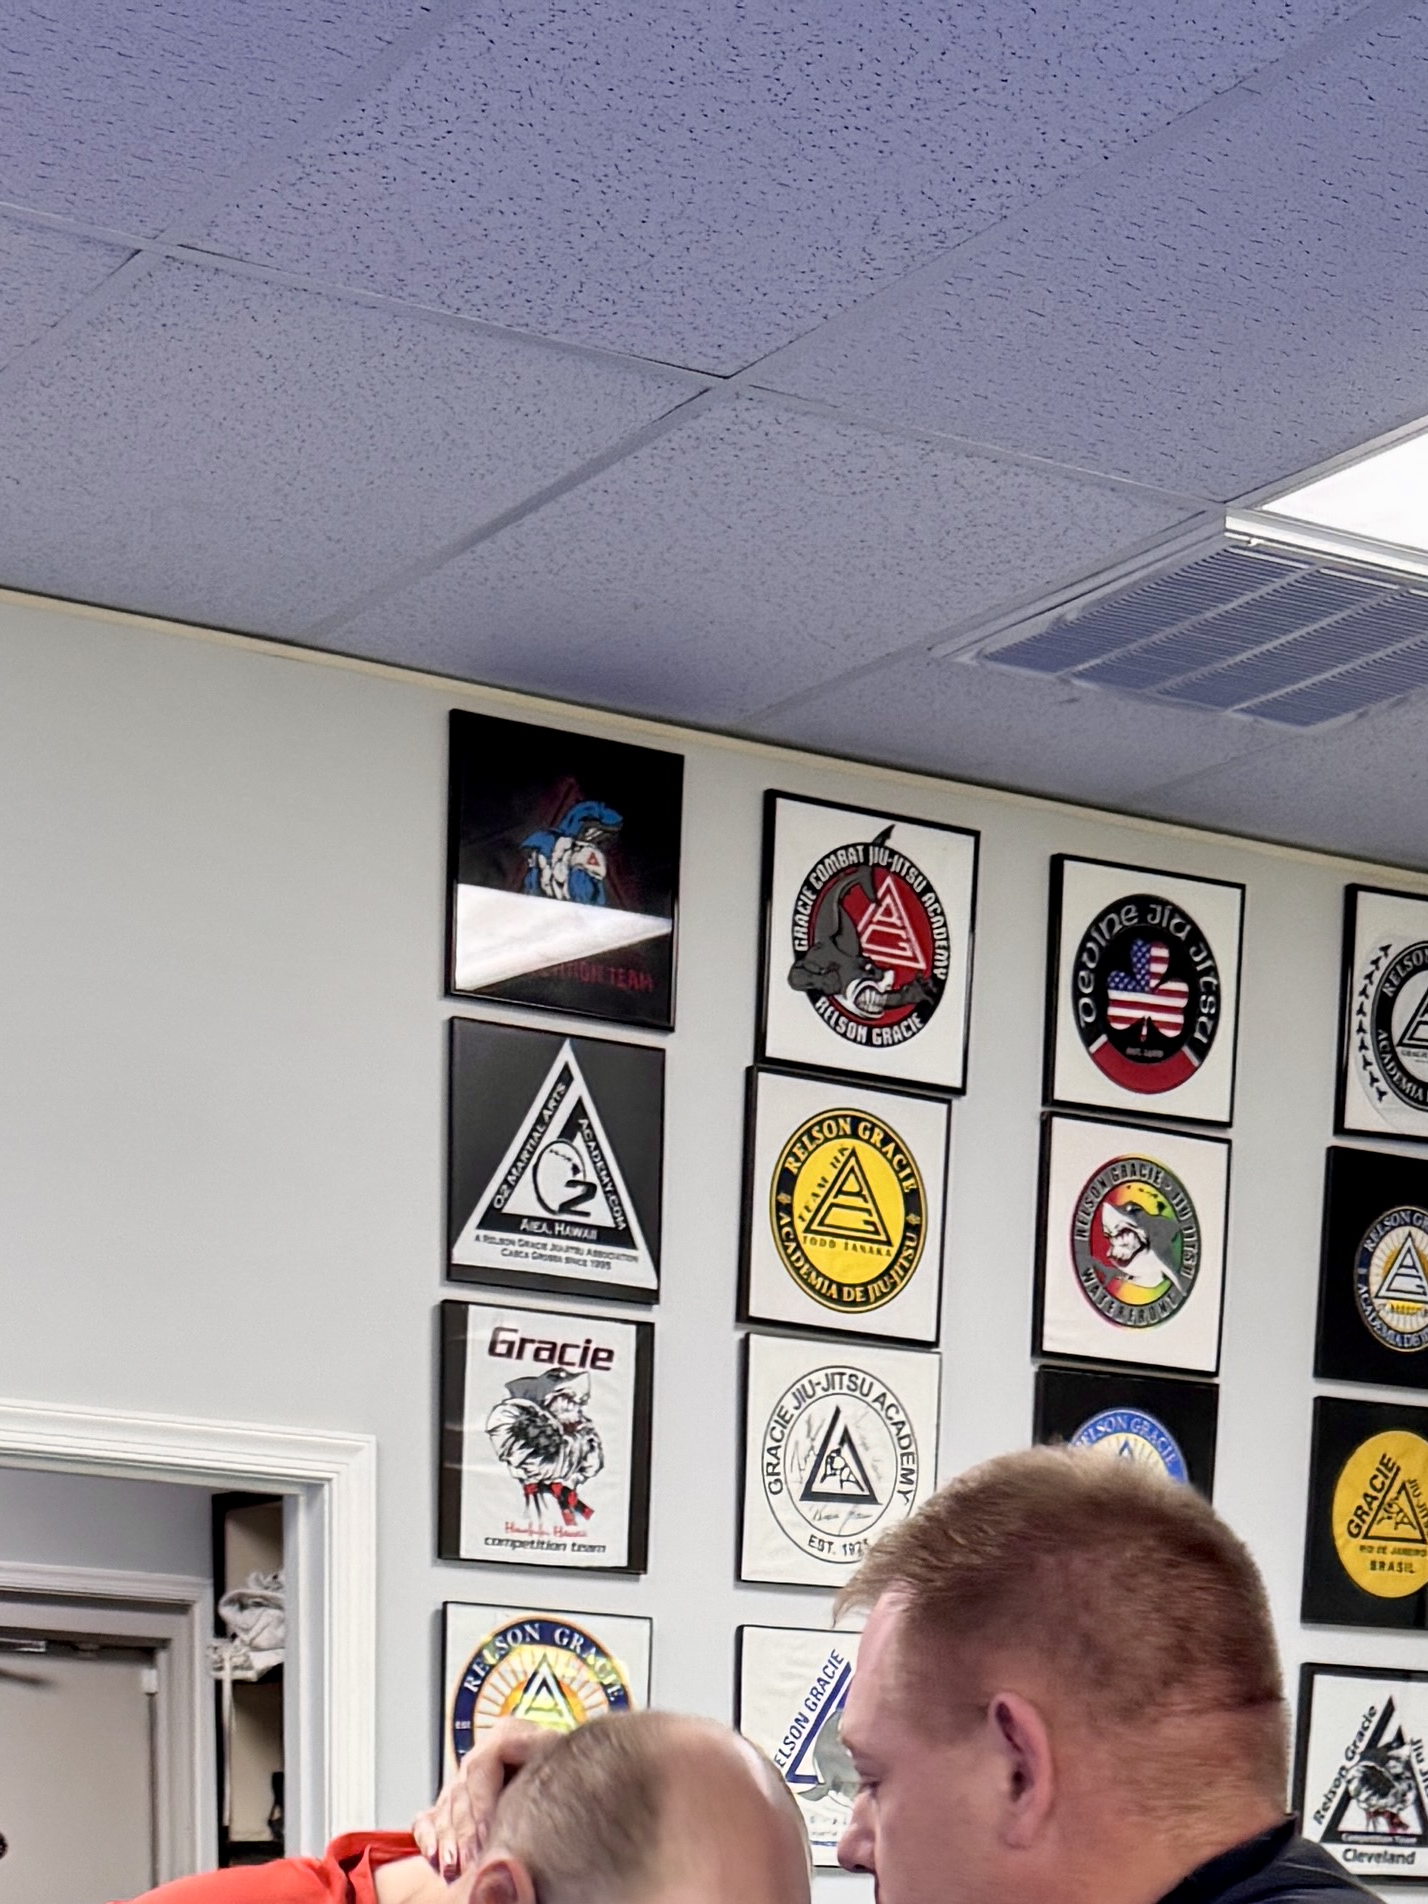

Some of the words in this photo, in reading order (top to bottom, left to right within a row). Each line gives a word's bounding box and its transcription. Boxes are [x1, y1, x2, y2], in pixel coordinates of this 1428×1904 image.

[794, 885, 816, 952] GRACIE
[809, 845, 865, 891] COMBAT
[923, 892, 950, 980] ACADEMY
[815, 996, 868, 1044] RELSON
[872, 1012, 924, 1046] GRACIE
[505, 1123, 546, 1186] MARTIAL
[542, 1082, 567, 1122] ARTS
[784, 1117, 852, 1175] RELSON
[857, 1121, 918, 1193] GRACIE
[578, 1118, 627, 1230] ACADEMY.COM
[1111, 1162, 1162, 1187] GRACIE
[778, 1213, 838, 1299] ACADEMIA
[842, 1285, 865, 1302] DE
[868, 1232, 918, 1304] JIU-JITSU
[488, 1326, 615, 1372] Gracie
[765, 1405, 794, 1496] GRACIE
[791, 1372, 874, 1410] JIU-JITSU
[871, 1392, 917, 1505] ACADEMY
[1347, 1453, 1397, 1539] GRACIE
[484, 1536, 567, 1553] competition
[571, 1541, 607, 1554] team
[1370, 1560, 1415, 1574] BRASIL
[464, 1623, 541, 1693] RELSON
[554, 1626, 624, 1701] GRACIE
[773, 1711, 810, 1768] ELSON
[804, 1648, 845, 1712] GRACIE
[1344, 1705, 1377, 1762] Gracie
[1342, 1849, 1416, 1866] Cleveland
